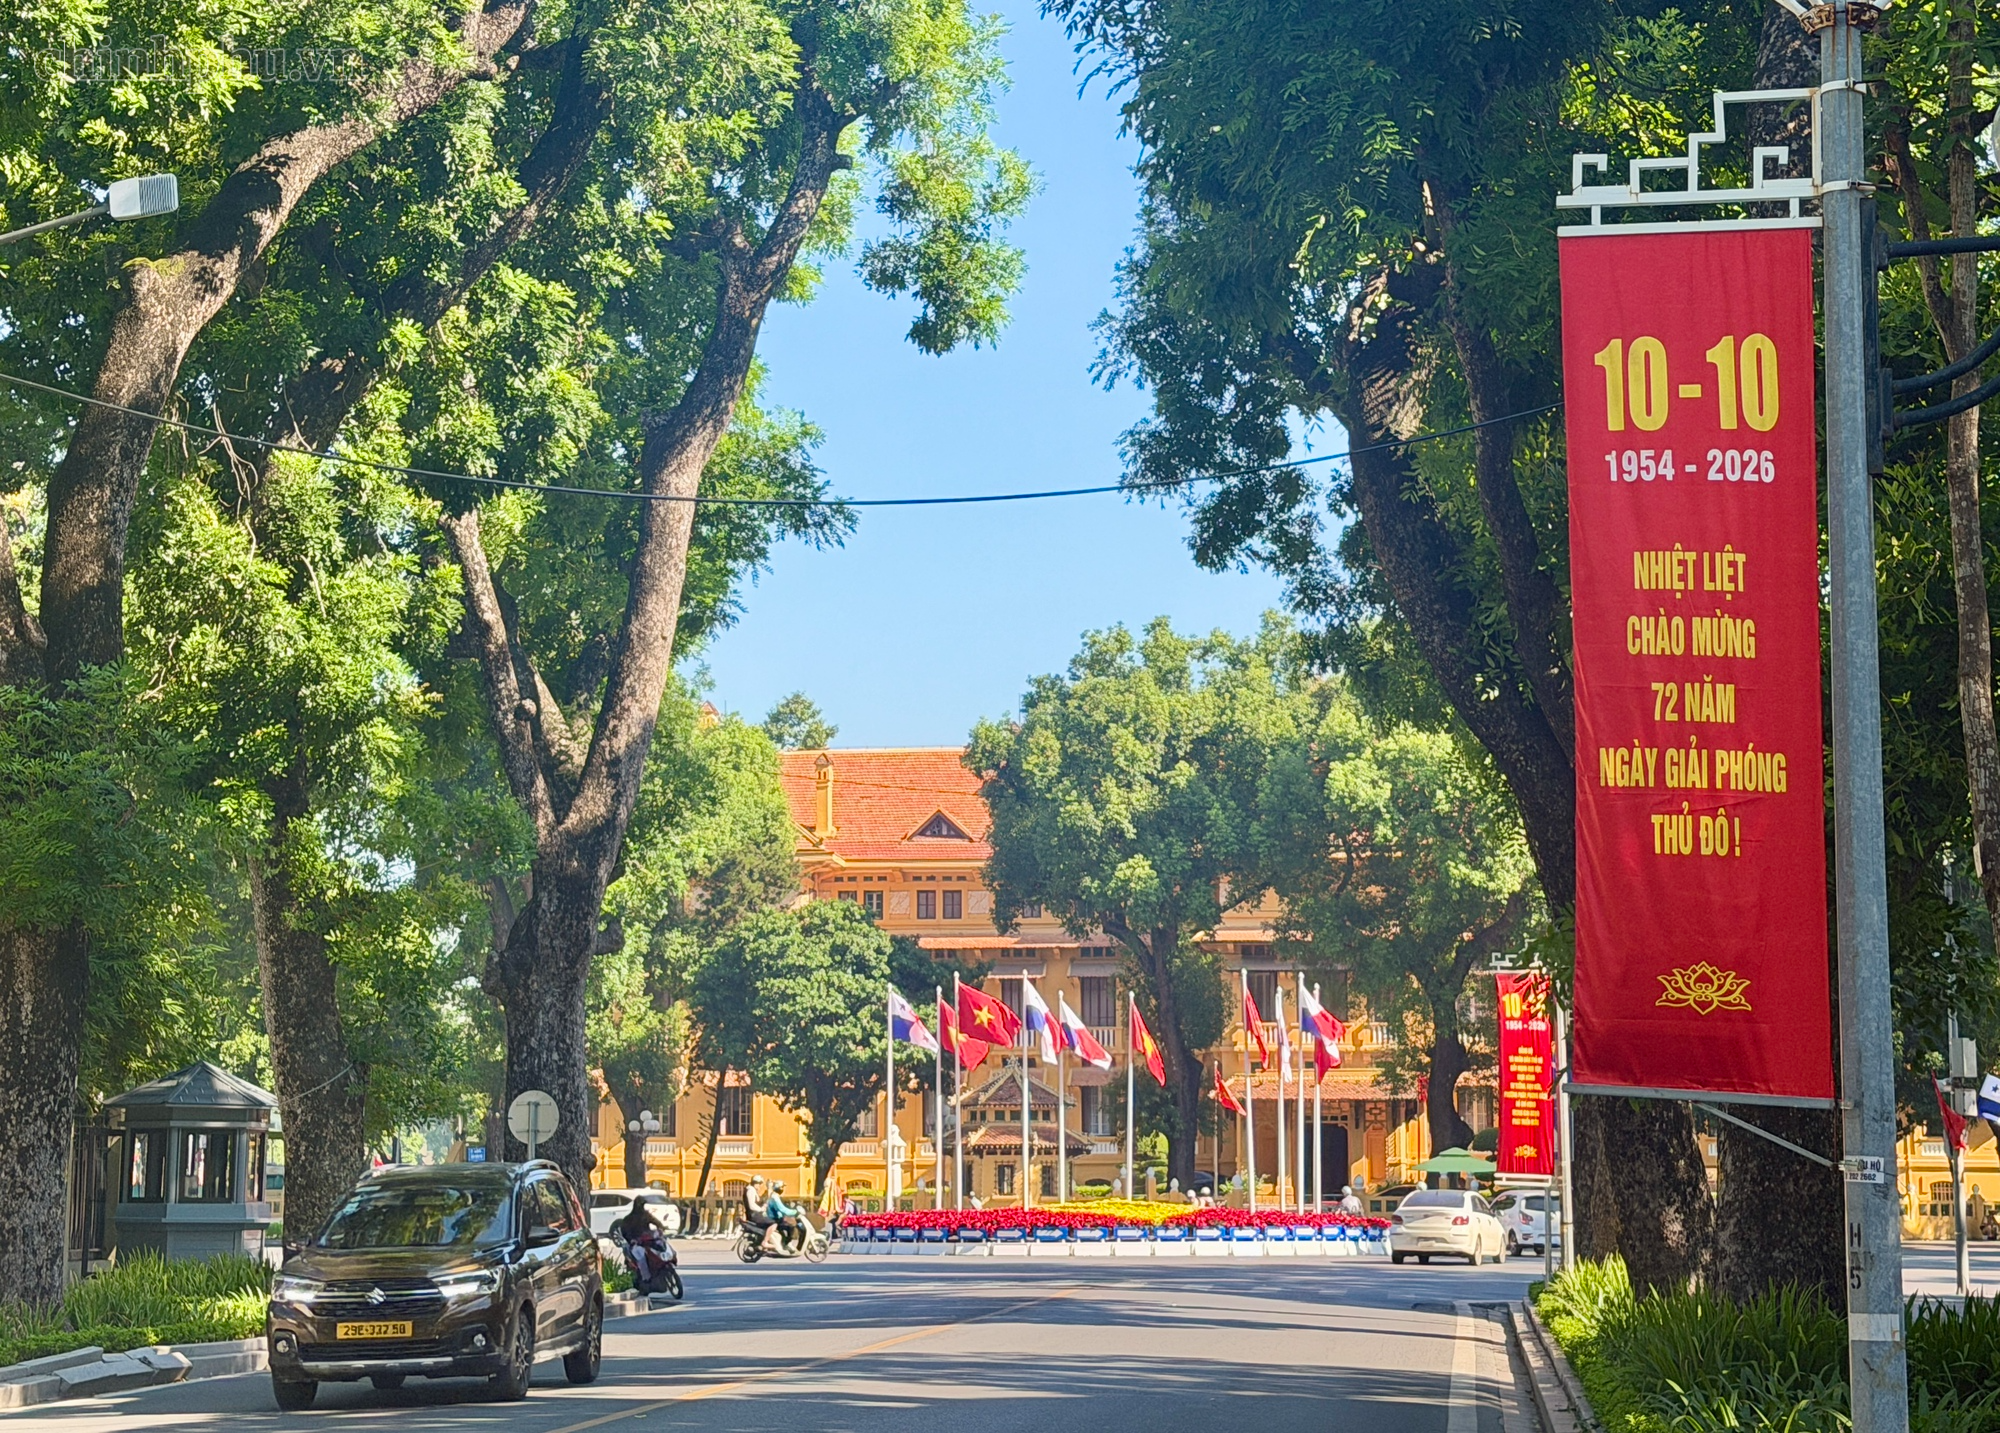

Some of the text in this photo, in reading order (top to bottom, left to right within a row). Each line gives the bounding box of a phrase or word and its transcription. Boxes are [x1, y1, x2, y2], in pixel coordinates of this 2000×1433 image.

[1605, 450, 1675, 482] 1954
[1707, 449, 1775, 483] 2026
[1634, 542, 1746, 600] NHIỆT LIỆT
[1627, 608, 1756, 659] CHÀO MỪNG
[1651, 674, 1735, 723] 72 NĂM
[1600, 735, 1788, 793] NGÀY GIẢI PHÓNG
[1651, 801, 1693, 856] THỦ
